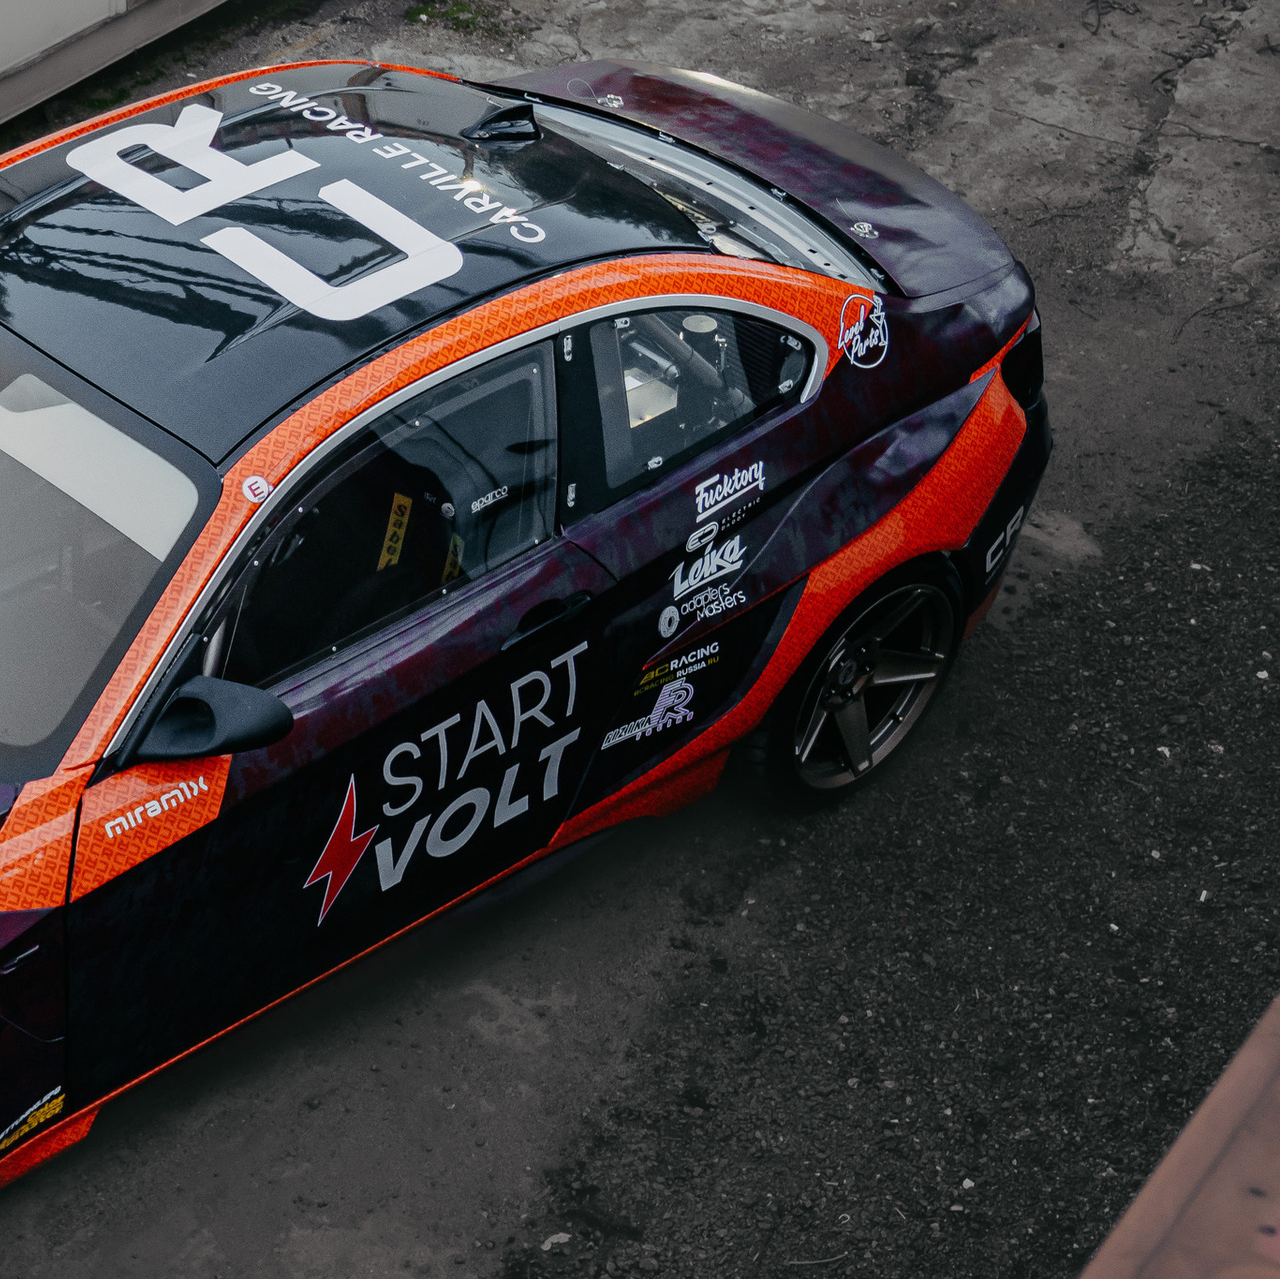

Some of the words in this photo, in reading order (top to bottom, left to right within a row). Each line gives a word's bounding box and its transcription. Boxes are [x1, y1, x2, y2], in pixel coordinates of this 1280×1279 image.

[249, 82, 384, 145] RACING
[65, 103, 464, 321] CR
[372, 142, 547, 243] CARVILLE
[247, 480, 265, 498] E
[694, 461, 766, 522] Fucktory
[680, 583, 730, 616] adapters
[382, 640, 589, 817] START
[104, 776, 209, 839] miramix
[375, 727, 581, 892] VOLT
